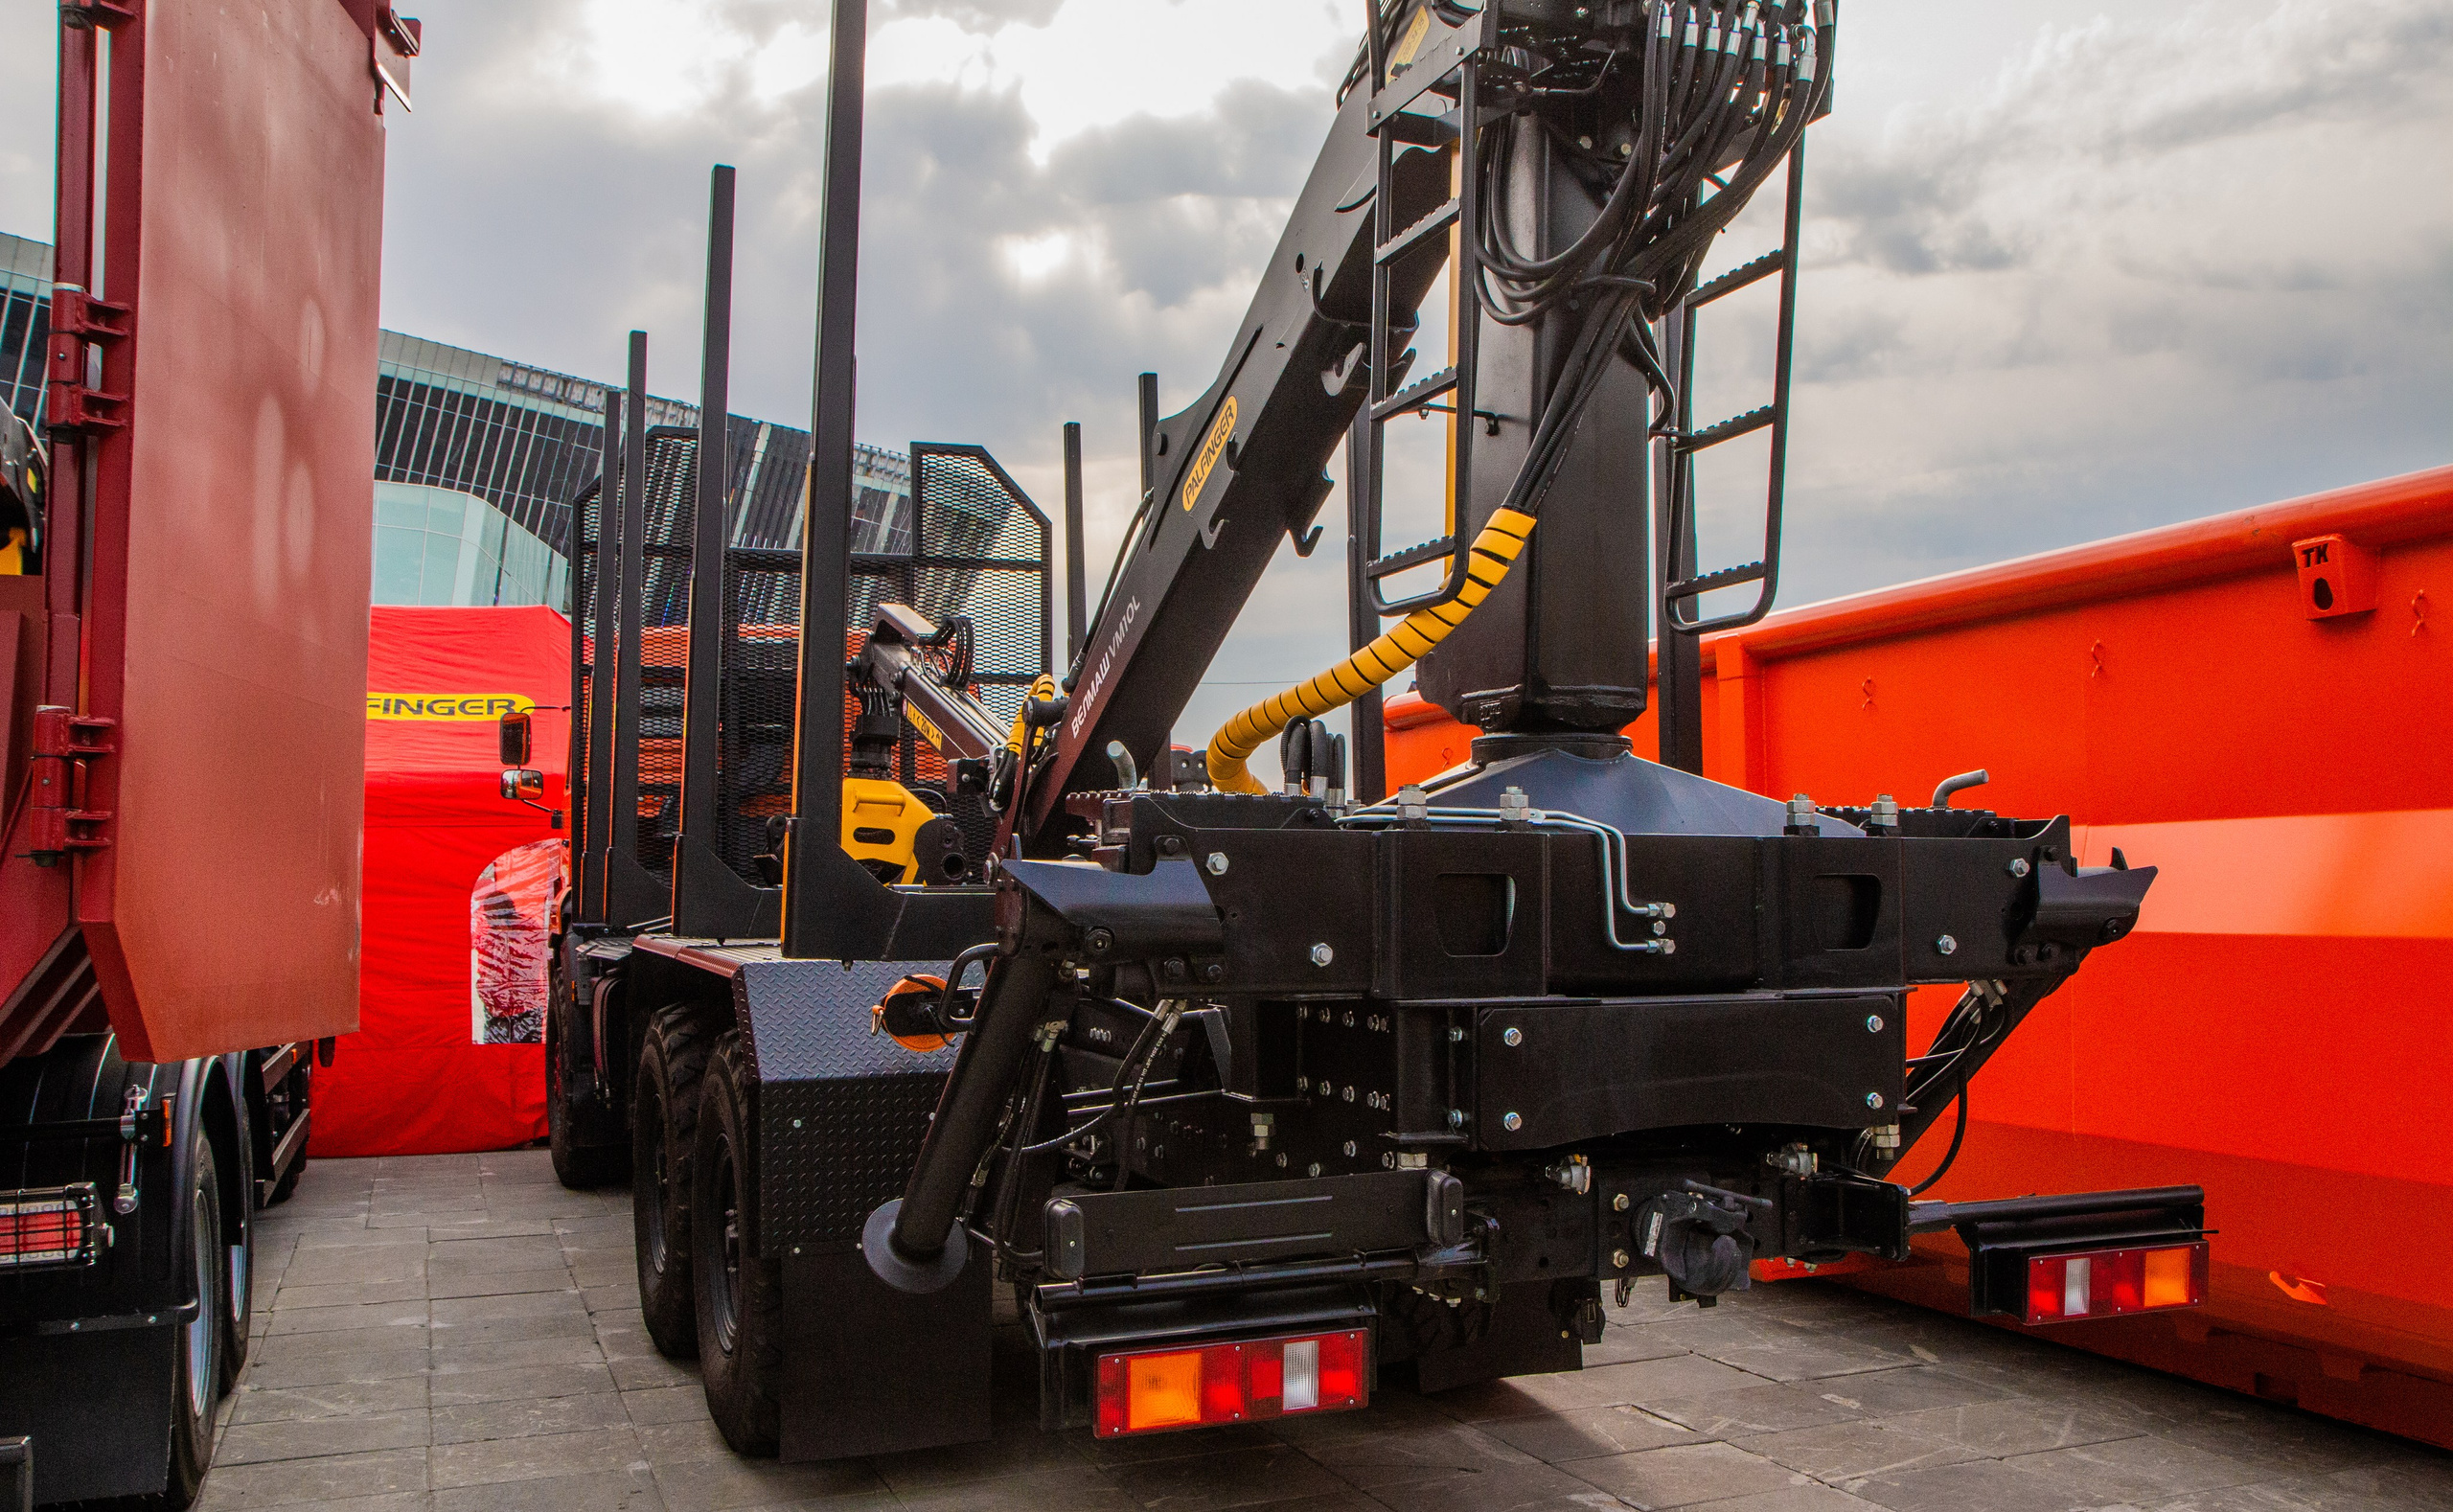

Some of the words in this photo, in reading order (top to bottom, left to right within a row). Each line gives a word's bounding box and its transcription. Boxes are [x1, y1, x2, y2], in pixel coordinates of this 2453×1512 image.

[1184, 404, 1234, 505] PALFINGER
[1071, 652, 1111, 739] ВЕЛМАШ
[1108, 595, 1140, 658] VM10L
